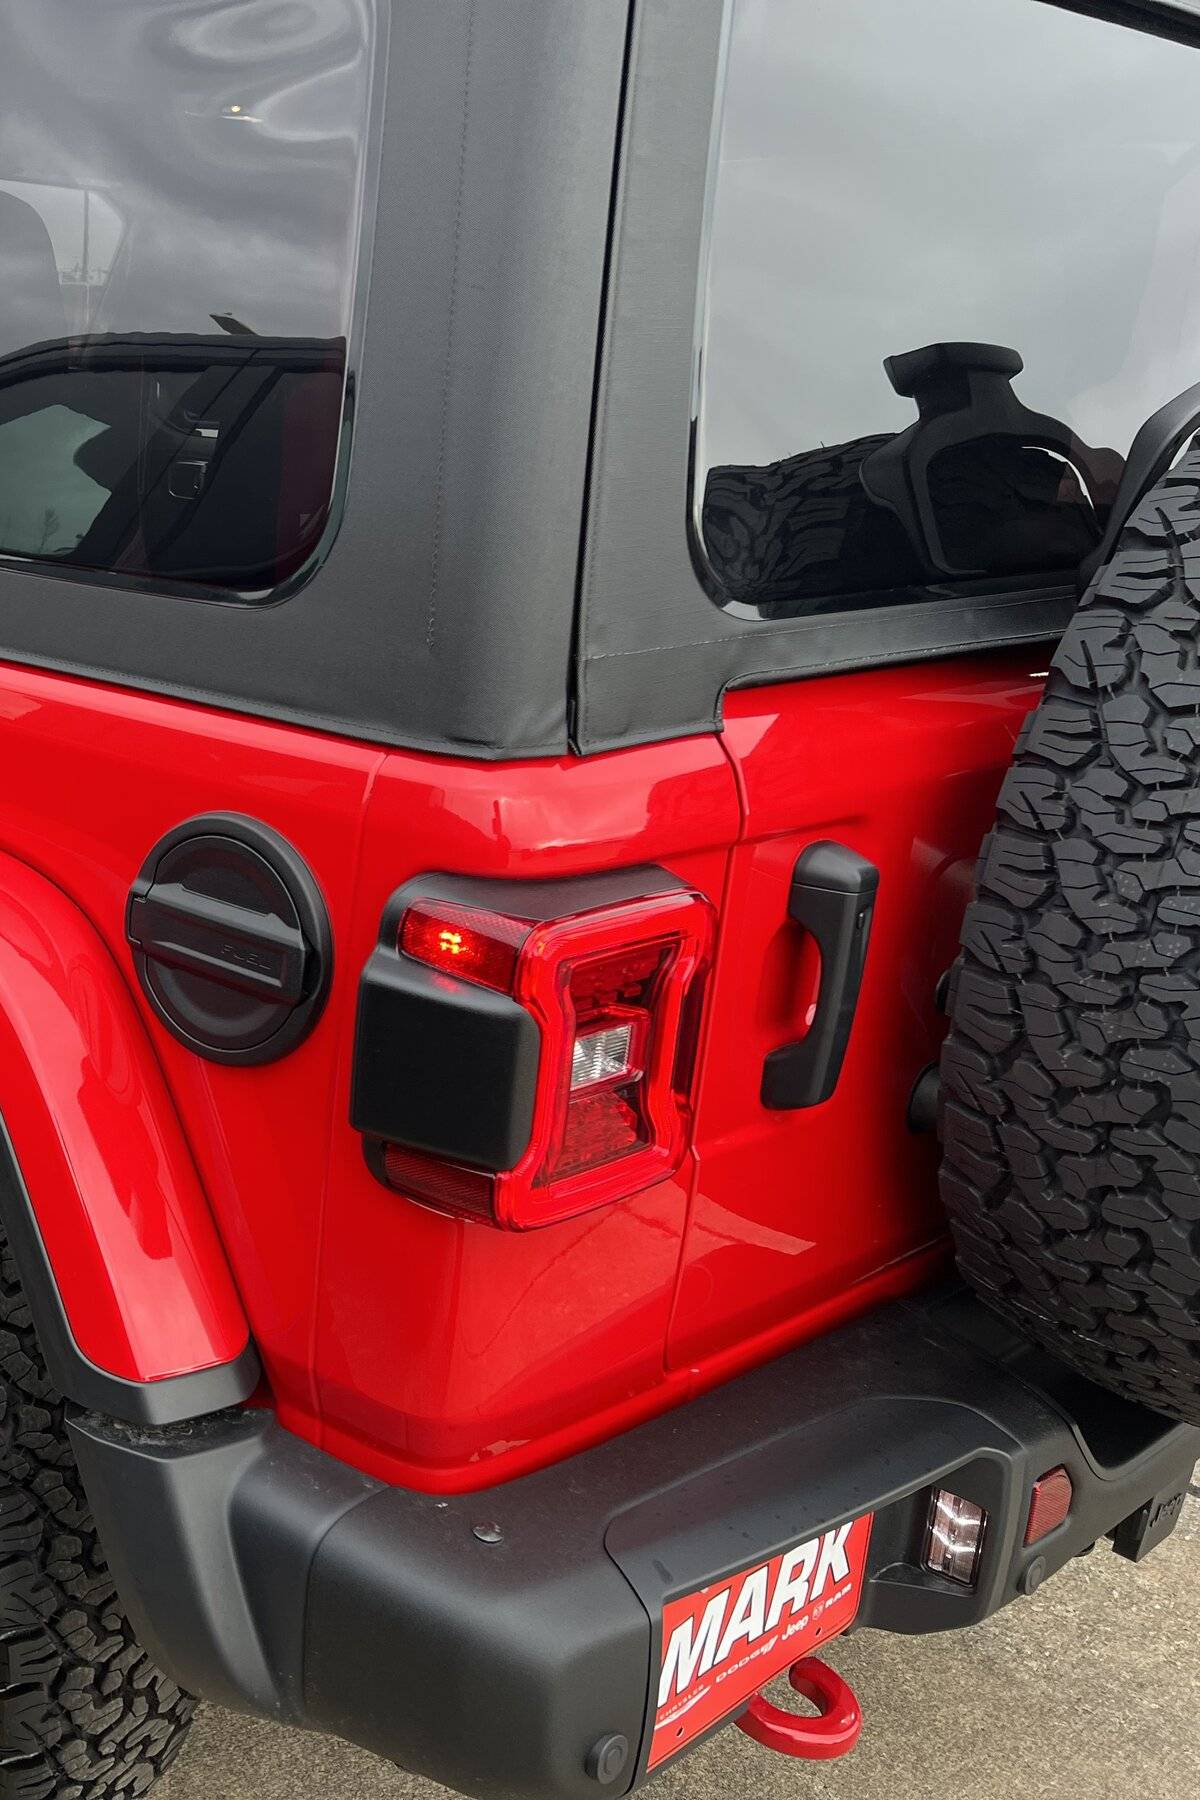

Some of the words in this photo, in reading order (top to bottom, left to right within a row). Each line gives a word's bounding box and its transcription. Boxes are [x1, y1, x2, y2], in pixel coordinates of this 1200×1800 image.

[220, 943, 272, 971] FUEL
[657, 1520, 854, 1709] MARK
[781, 1614, 810, 1641] Jeep
[824, 1582, 853, 1609] RAM
